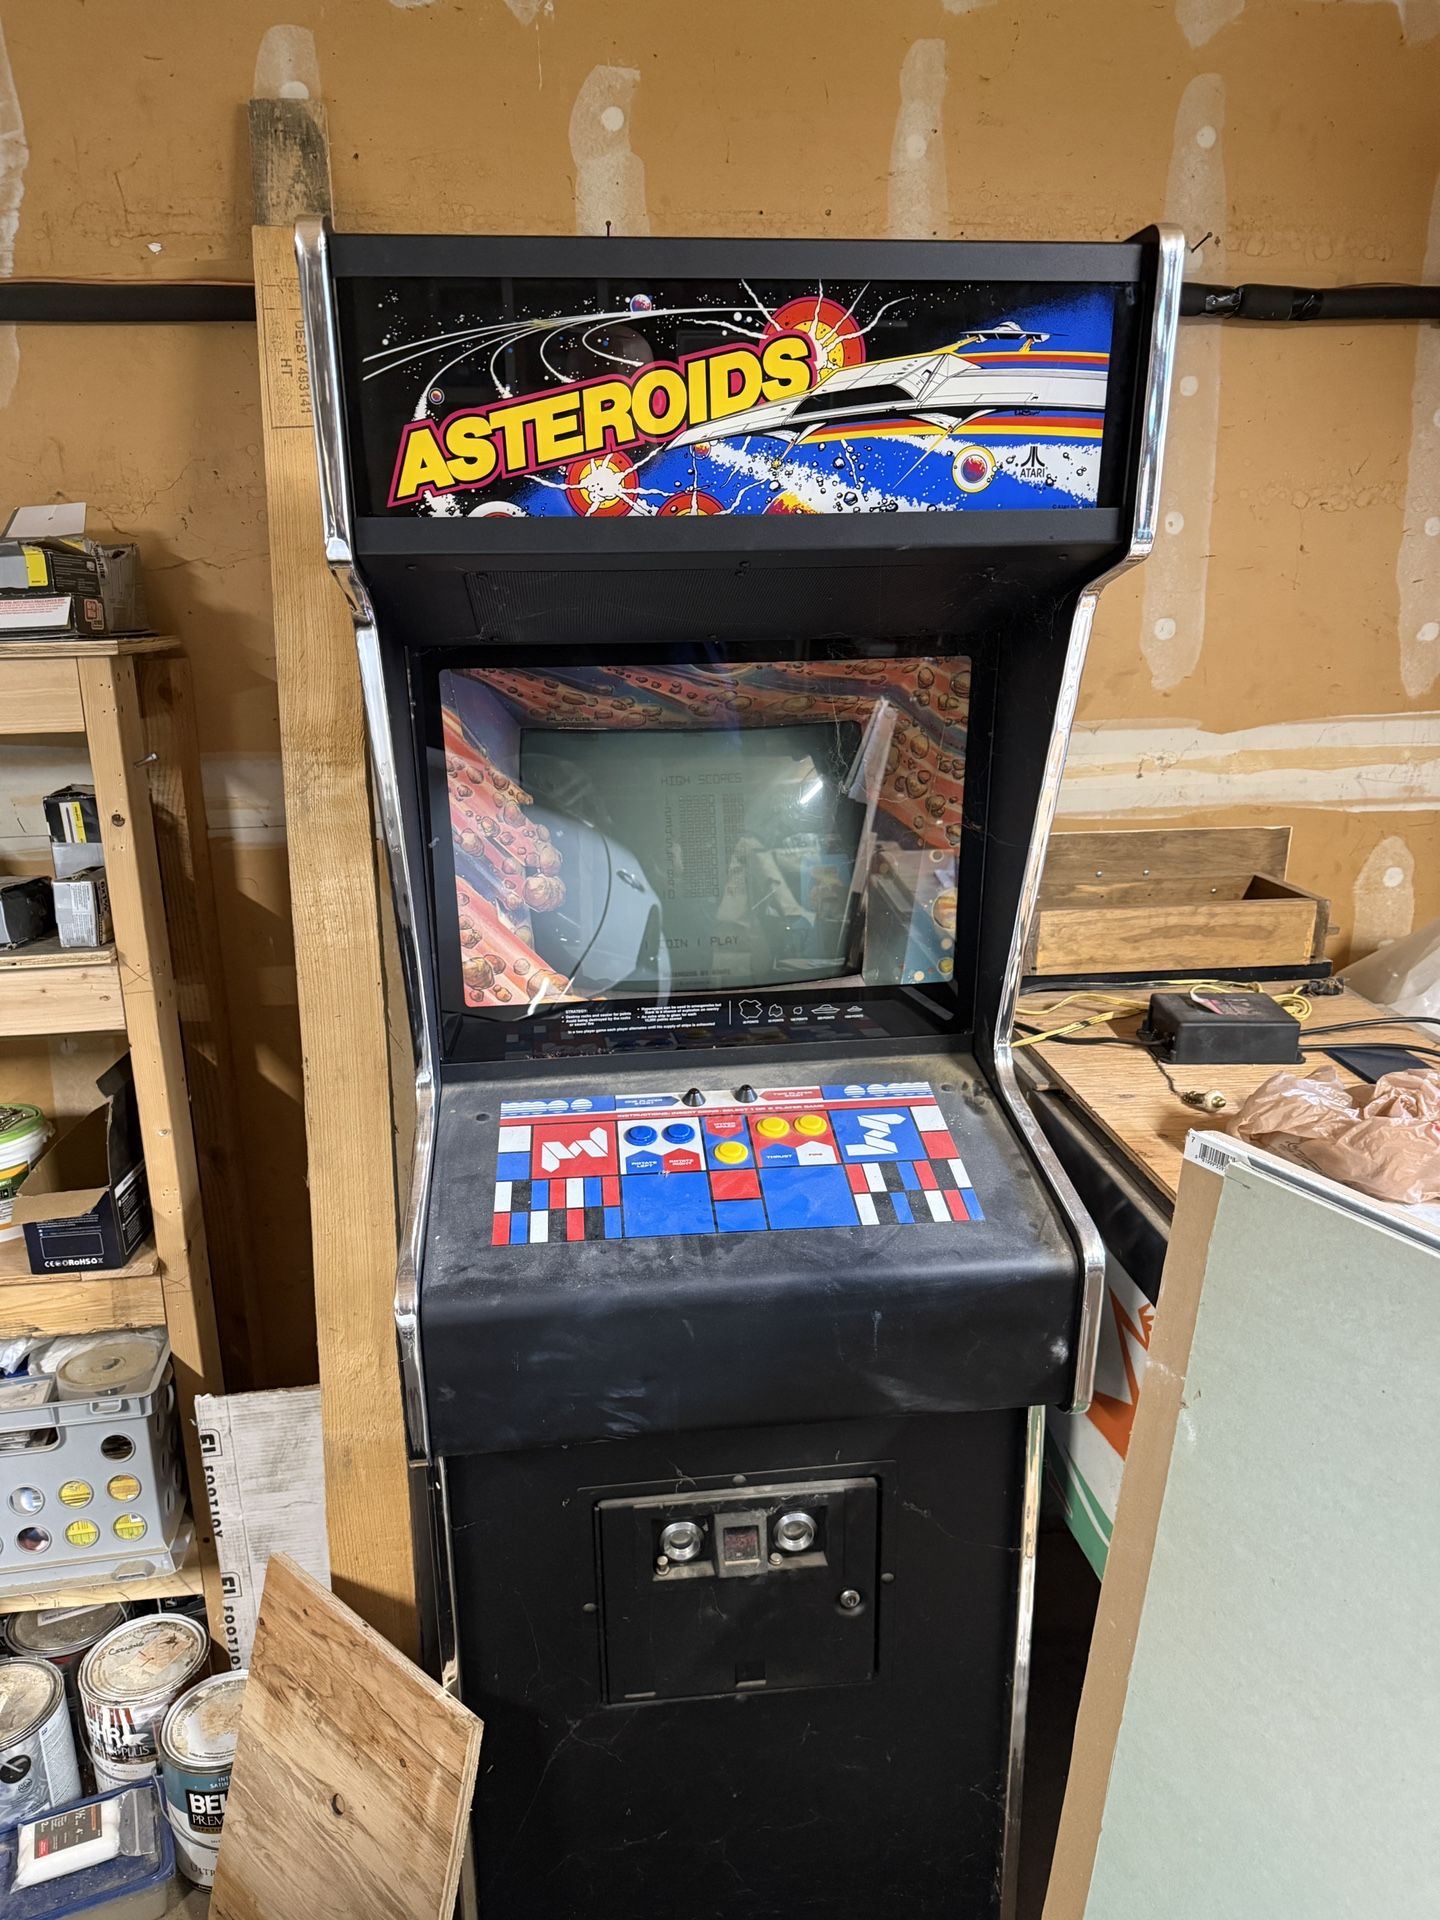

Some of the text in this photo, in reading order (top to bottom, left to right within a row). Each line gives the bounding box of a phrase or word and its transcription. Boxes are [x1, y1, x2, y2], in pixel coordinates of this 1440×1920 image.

[281, 358, 293, 377] HT
[397, 337, 815, 499] ASTEROIDS
[1020, 468, 1045, 478] ATARI
[661, 772, 742, 786] HIGH SCORES
[710, 935, 739, 946] PLAY
[68, 1258, 91, 1266] RoHS
